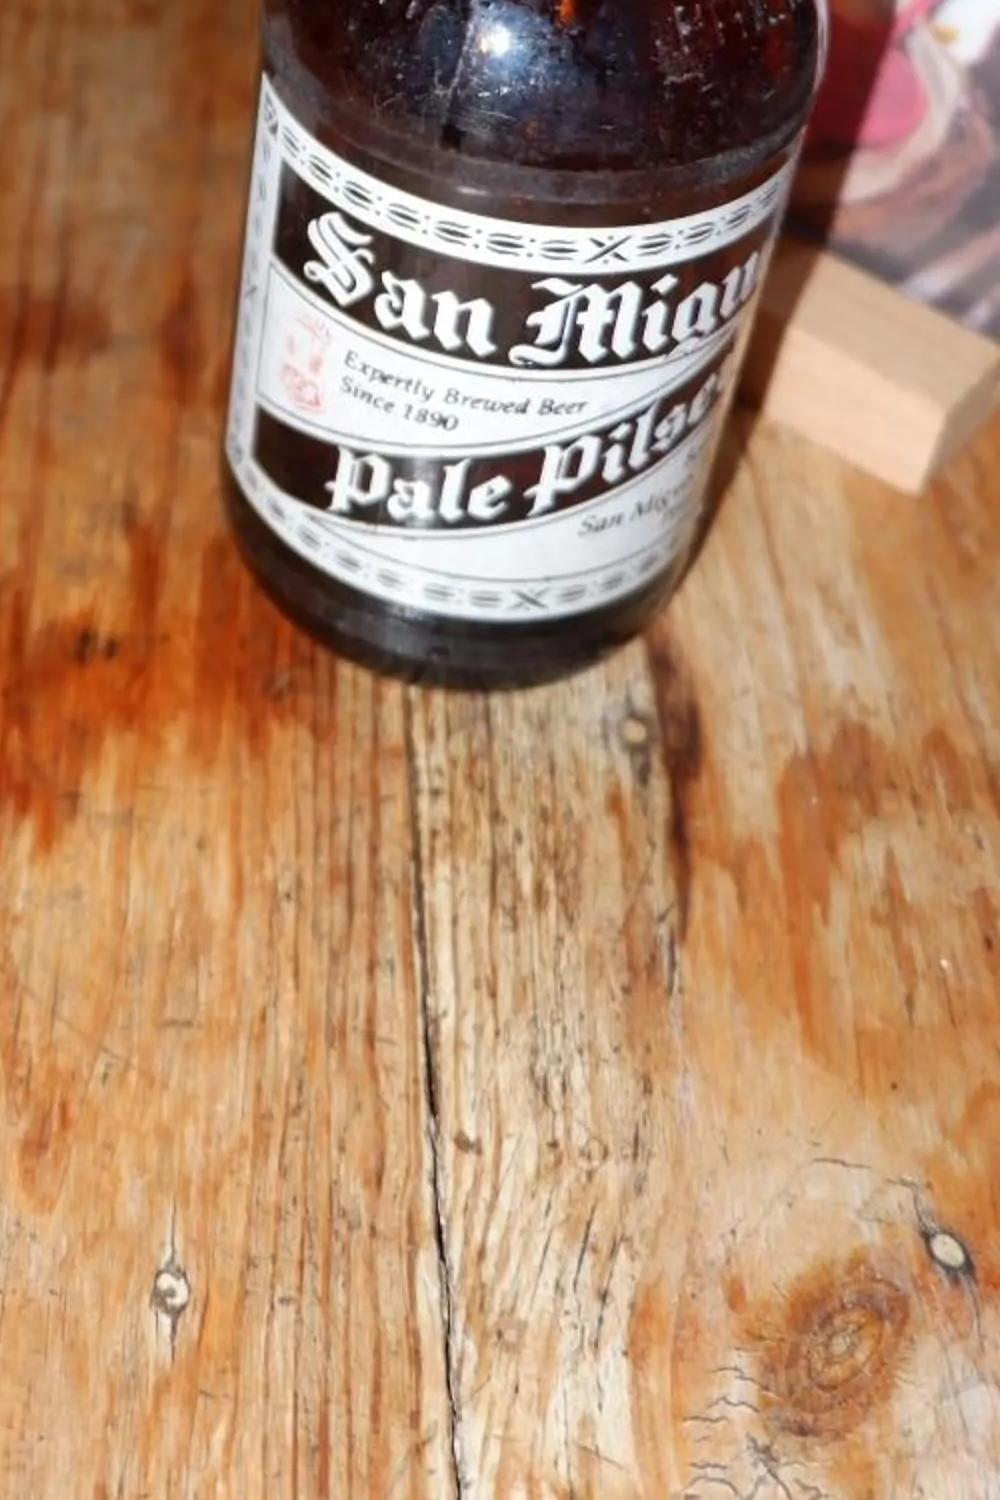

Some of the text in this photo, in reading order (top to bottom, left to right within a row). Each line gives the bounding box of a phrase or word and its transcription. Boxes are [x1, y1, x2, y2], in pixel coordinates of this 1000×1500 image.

[303, 211, 763, 369] San Migu
[340, 375, 460, 433] Since 1890
[343, 349, 589, 416] Expertly Brewed Beer
[324, 372, 723, 522] Pale Pilse
[577, 514, 625, 538] San
